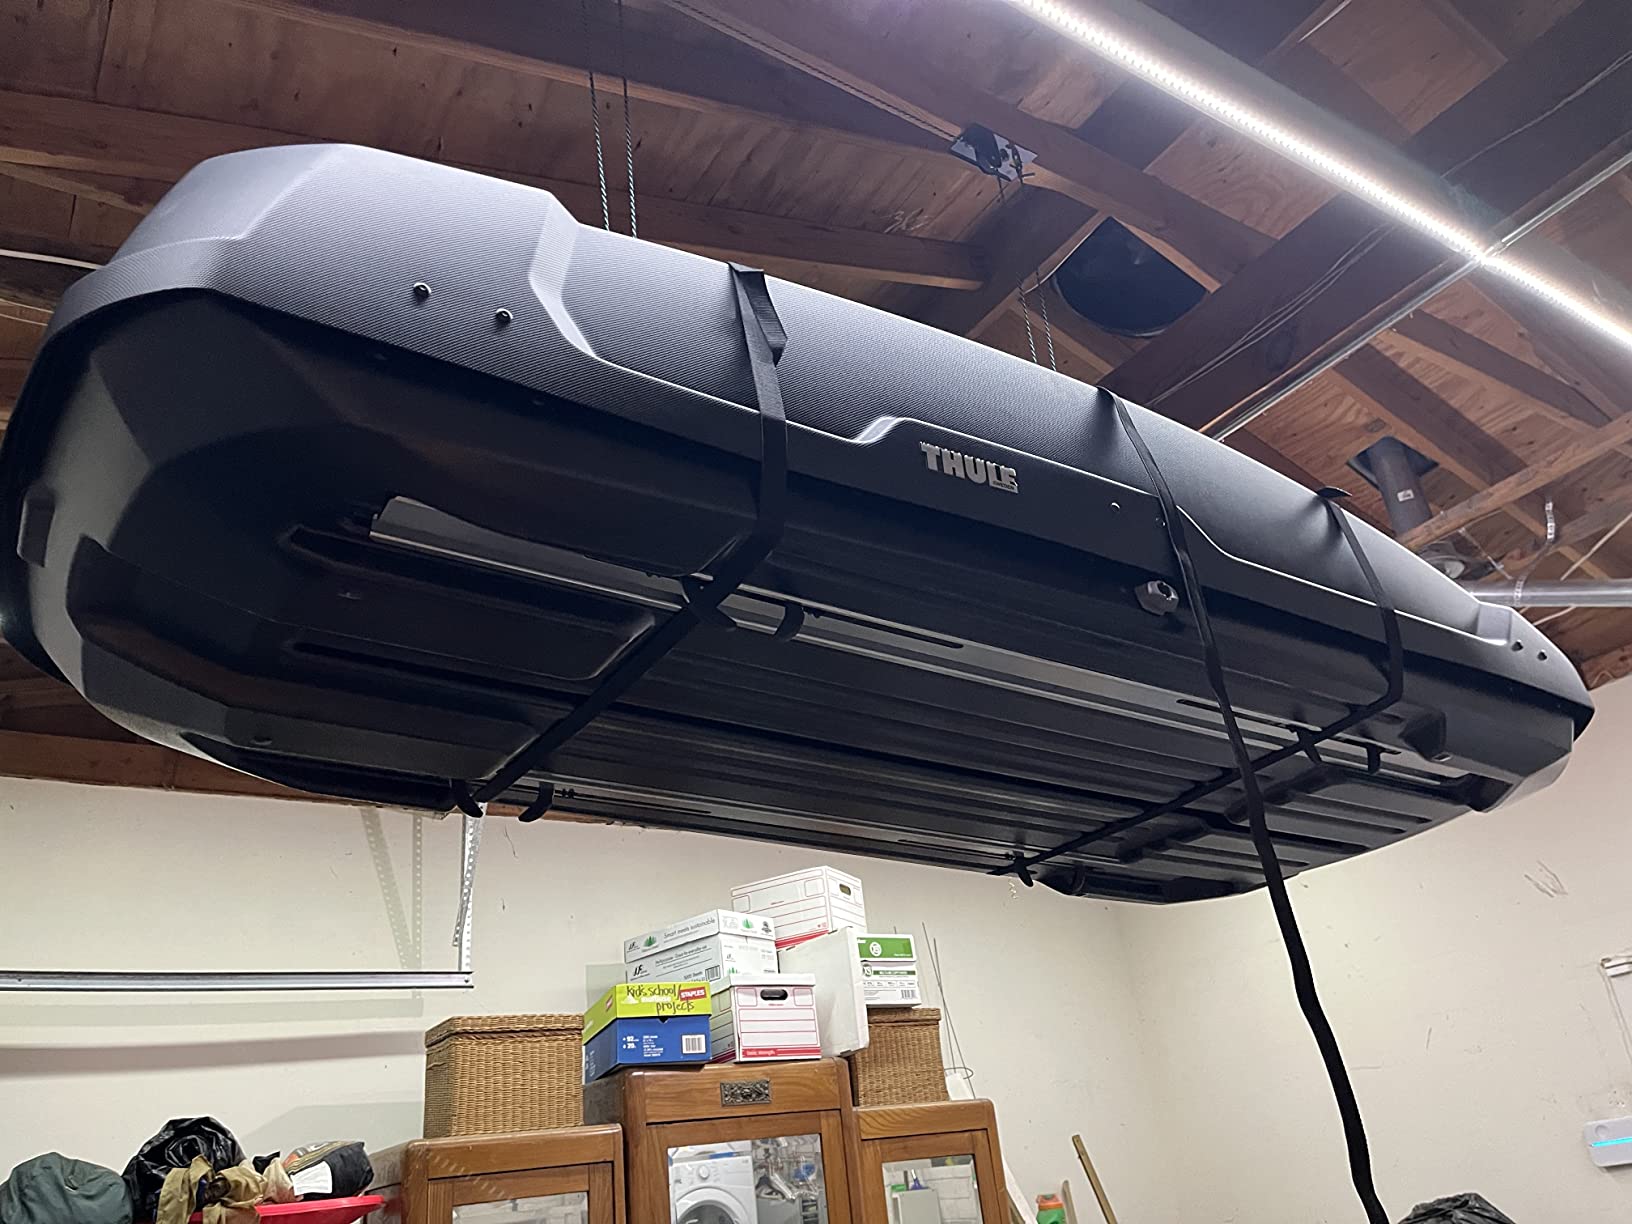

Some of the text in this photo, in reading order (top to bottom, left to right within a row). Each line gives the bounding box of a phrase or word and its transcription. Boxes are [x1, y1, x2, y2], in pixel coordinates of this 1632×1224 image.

[919, 441, 1018, 493] THULE
[680, 988, 705, 999] STAPLES
[656, 999, 695, 1015] projects
